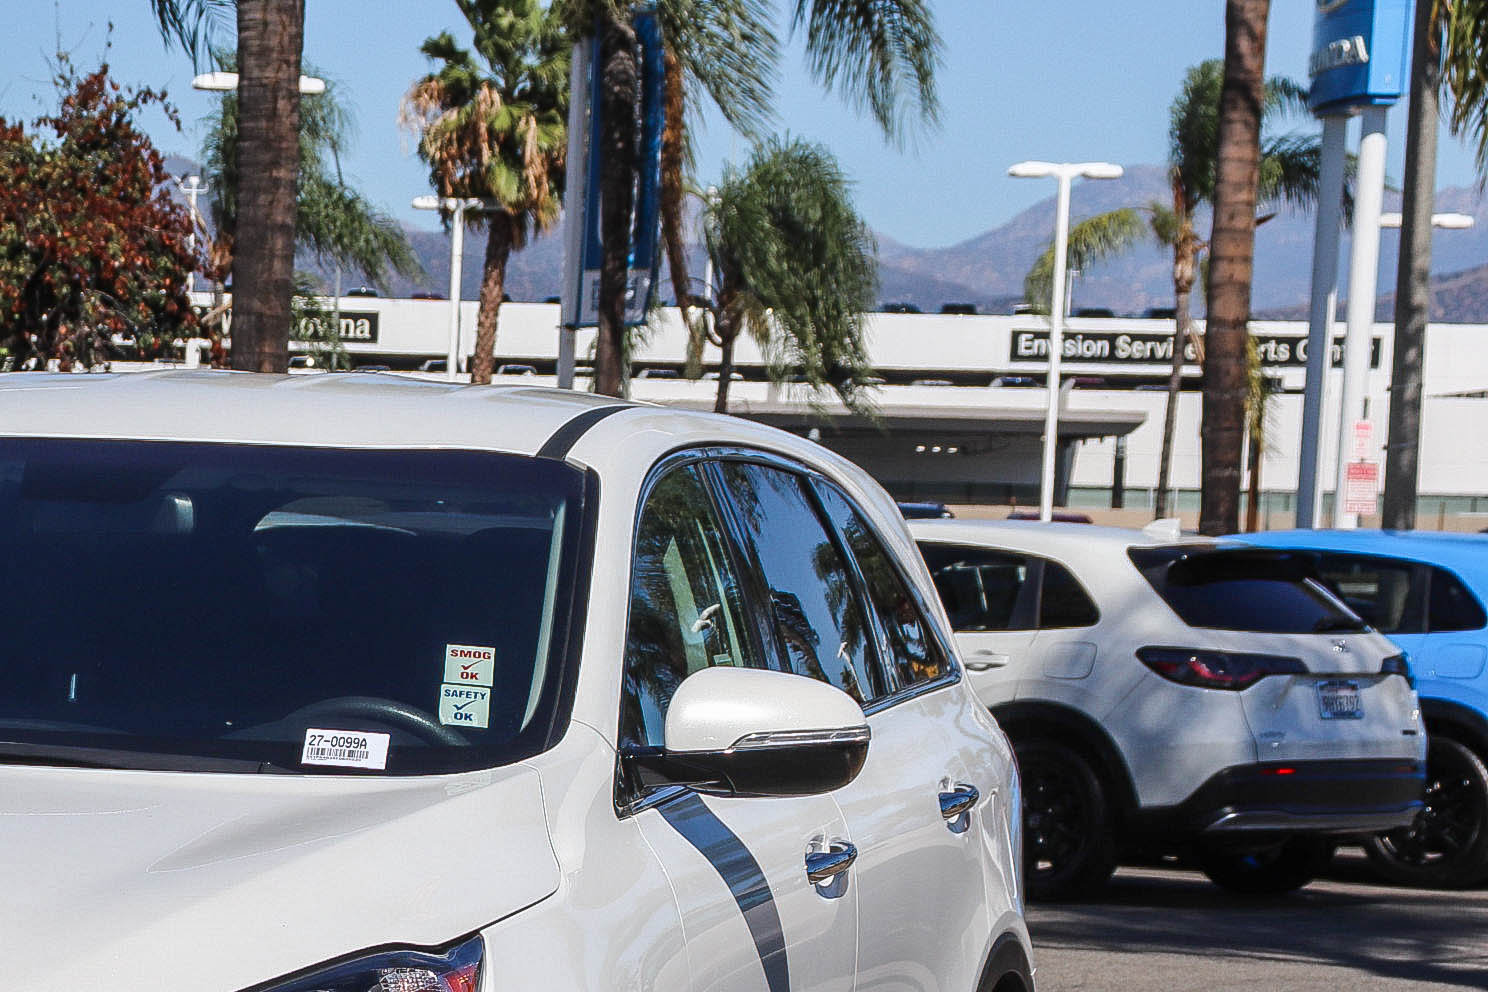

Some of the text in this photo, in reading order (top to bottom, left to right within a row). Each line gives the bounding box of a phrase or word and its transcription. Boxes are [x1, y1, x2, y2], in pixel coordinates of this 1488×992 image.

[450, 649, 492, 660] SMOG
[460, 671, 479, 681] OK
[444, 688, 487, 700] SAFETY
[453, 711, 473, 722] OK
[308, 734, 368, 750] 27-0099A
